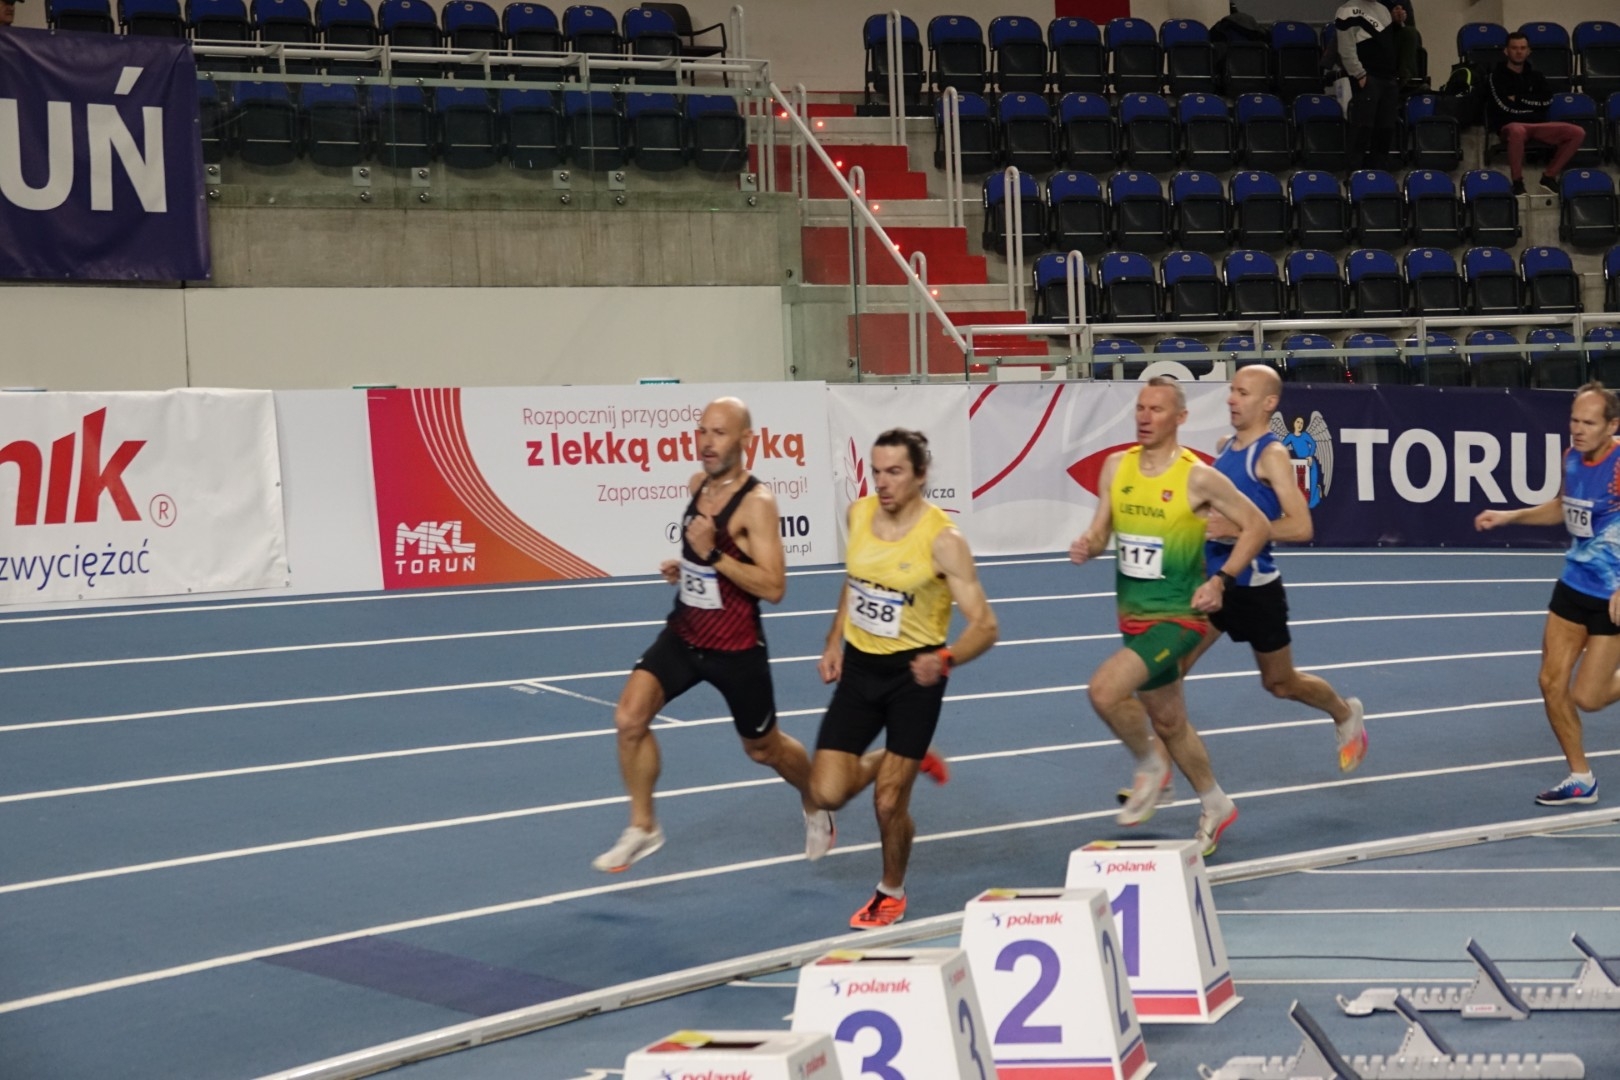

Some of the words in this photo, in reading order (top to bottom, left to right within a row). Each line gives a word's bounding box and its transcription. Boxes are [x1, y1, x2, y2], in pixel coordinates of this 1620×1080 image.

[0, 66, 168, 213] UŃ
[523, 405, 618, 430] Rozpocznij
[526, 441, 545, 467] z
[551, 431, 651, 473] lekką
[657, 427, 806, 471] atlyką
[1340, 427, 1562, 505] TORU
[1119, 503, 1166, 519] LIETUVA
[1567, 508, 1588, 527] 176
[395, 520, 476, 556] MKL
[1119, 545, 1157, 565] 117
[395, 555, 476, 575] TORUŃ
[856, 595, 895, 623] 258
[1107, 860, 1157, 875] polanik
[1007, 912, 1063, 929] polanik
[1110, 883, 1140, 978] 1
[1194, 876, 1217, 968] 1
[847, 977, 912, 997] polanik
[993, 938, 1064, 1046] 2
[1102, 929, 1131, 1036] 2
[834, 1009, 907, 1080] 3
[957, 997, 987, 1080] 3
